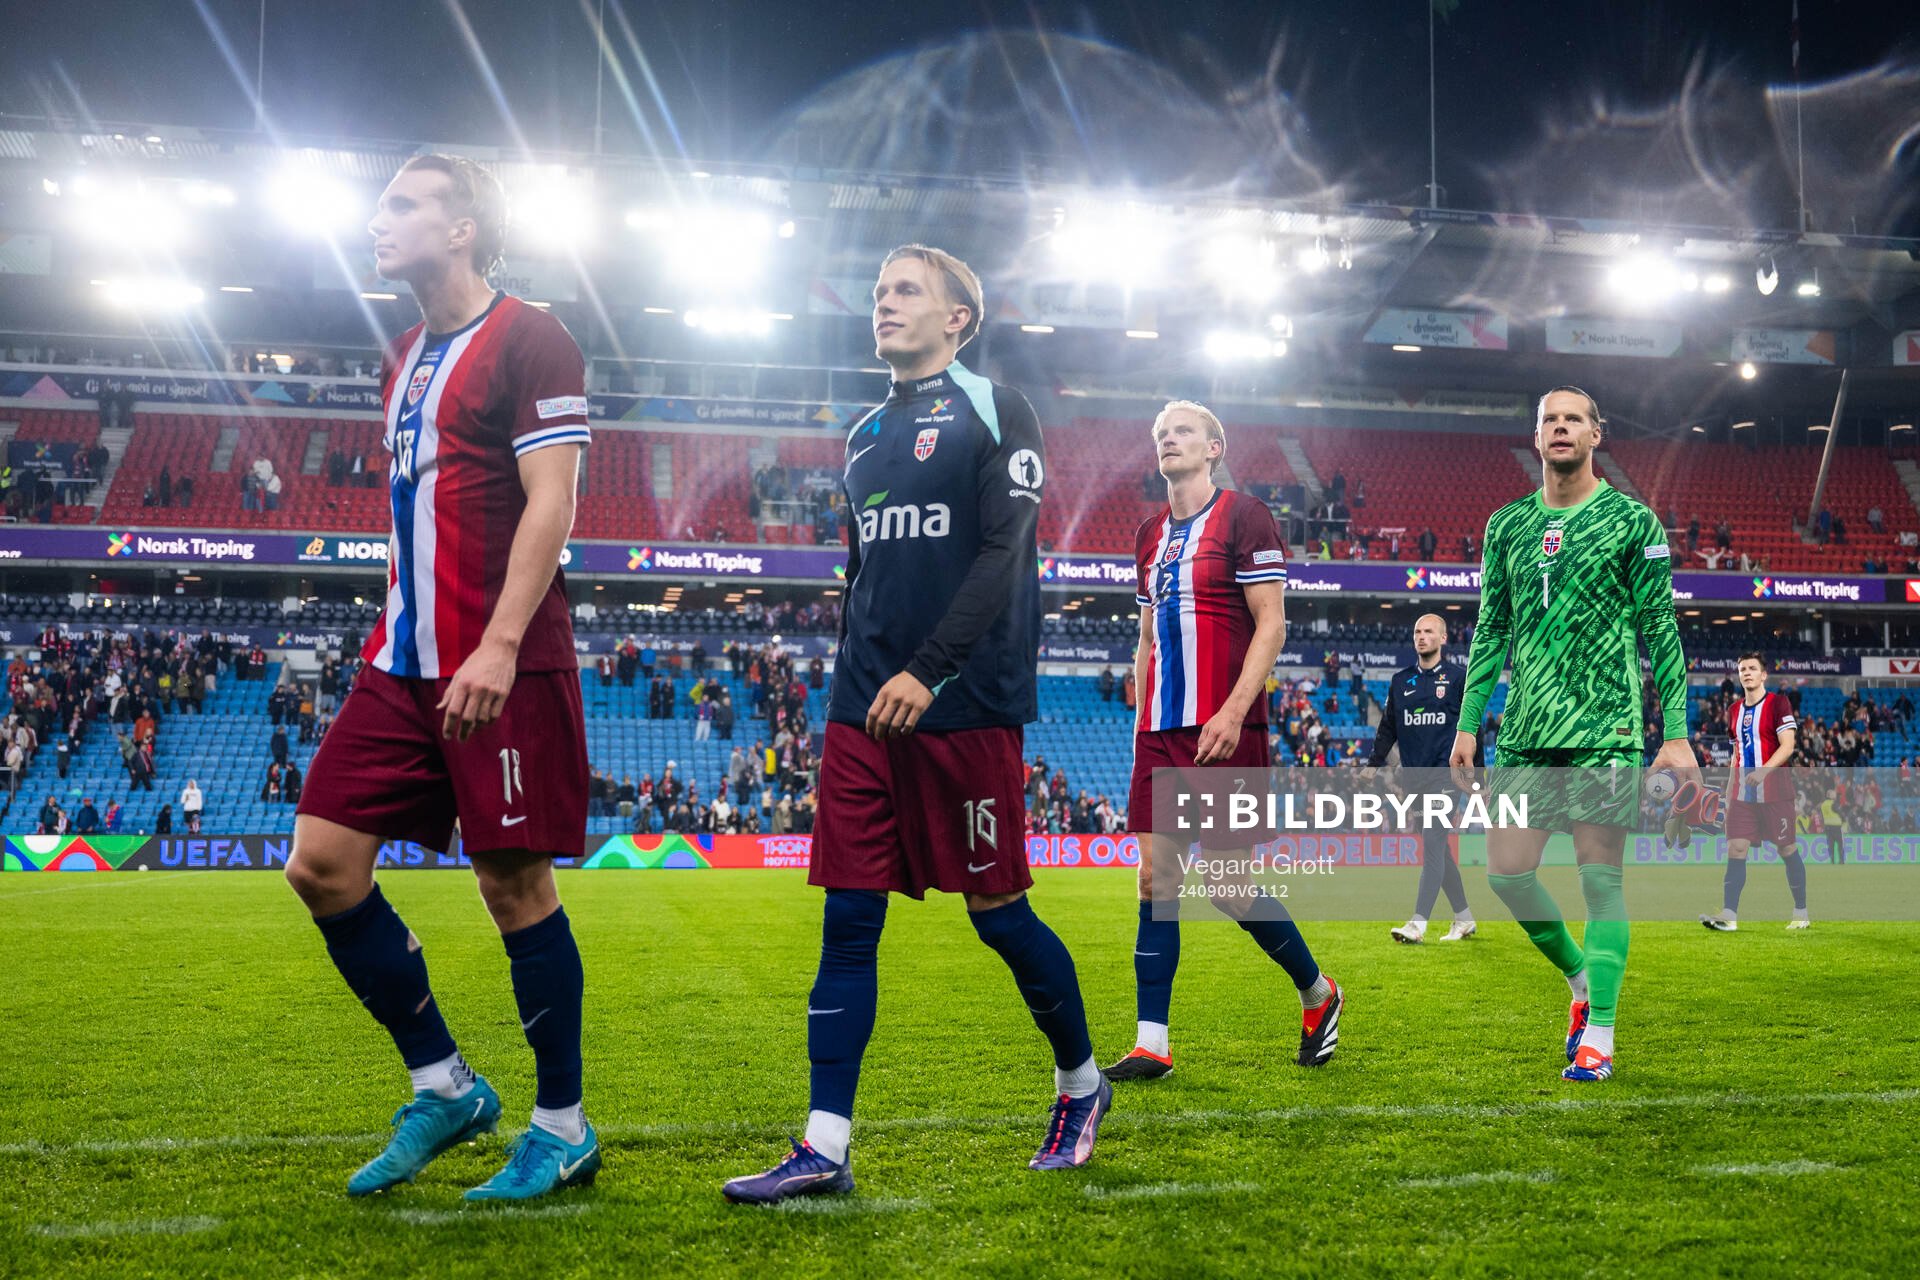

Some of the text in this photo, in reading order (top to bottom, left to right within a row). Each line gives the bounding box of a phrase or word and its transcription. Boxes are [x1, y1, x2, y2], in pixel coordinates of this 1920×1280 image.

[916, 377, 943, 392] bama
[326, 390, 358, 404] Norsk
[392, 428, 416, 486] 18
[137, 536, 255, 560] Norsk Tipping
[655, 551, 763, 574] Norsk Tipping
[1057, 562, 1102, 579] Norsk
[1429, 571, 1471, 587] Norsk
[1541, 572, 1549, 610] 1
[1774, 580, 1860, 600] Norsk Tipping
[1048, 647, 1110, 660] Norsk Tipping
[1364, 653, 1396, 665] Tipping
[1701, 659, 1725, 669] Norsk
[1788, 660, 1840, 672] Norsk Tipping
[1403, 708, 1446, 726] bama
[1743, 732, 1752, 748] 3
[1608, 758, 1617, 796] 1
[963, 798, 998, 851] 16
[160, 839, 252, 867] UEFA
[756, 835, 814, 856] THON
[1024, 836, 1081, 866] RIS
[1088, 836, 1141, 866] OG
[1634, 836, 1708, 863] BEST
